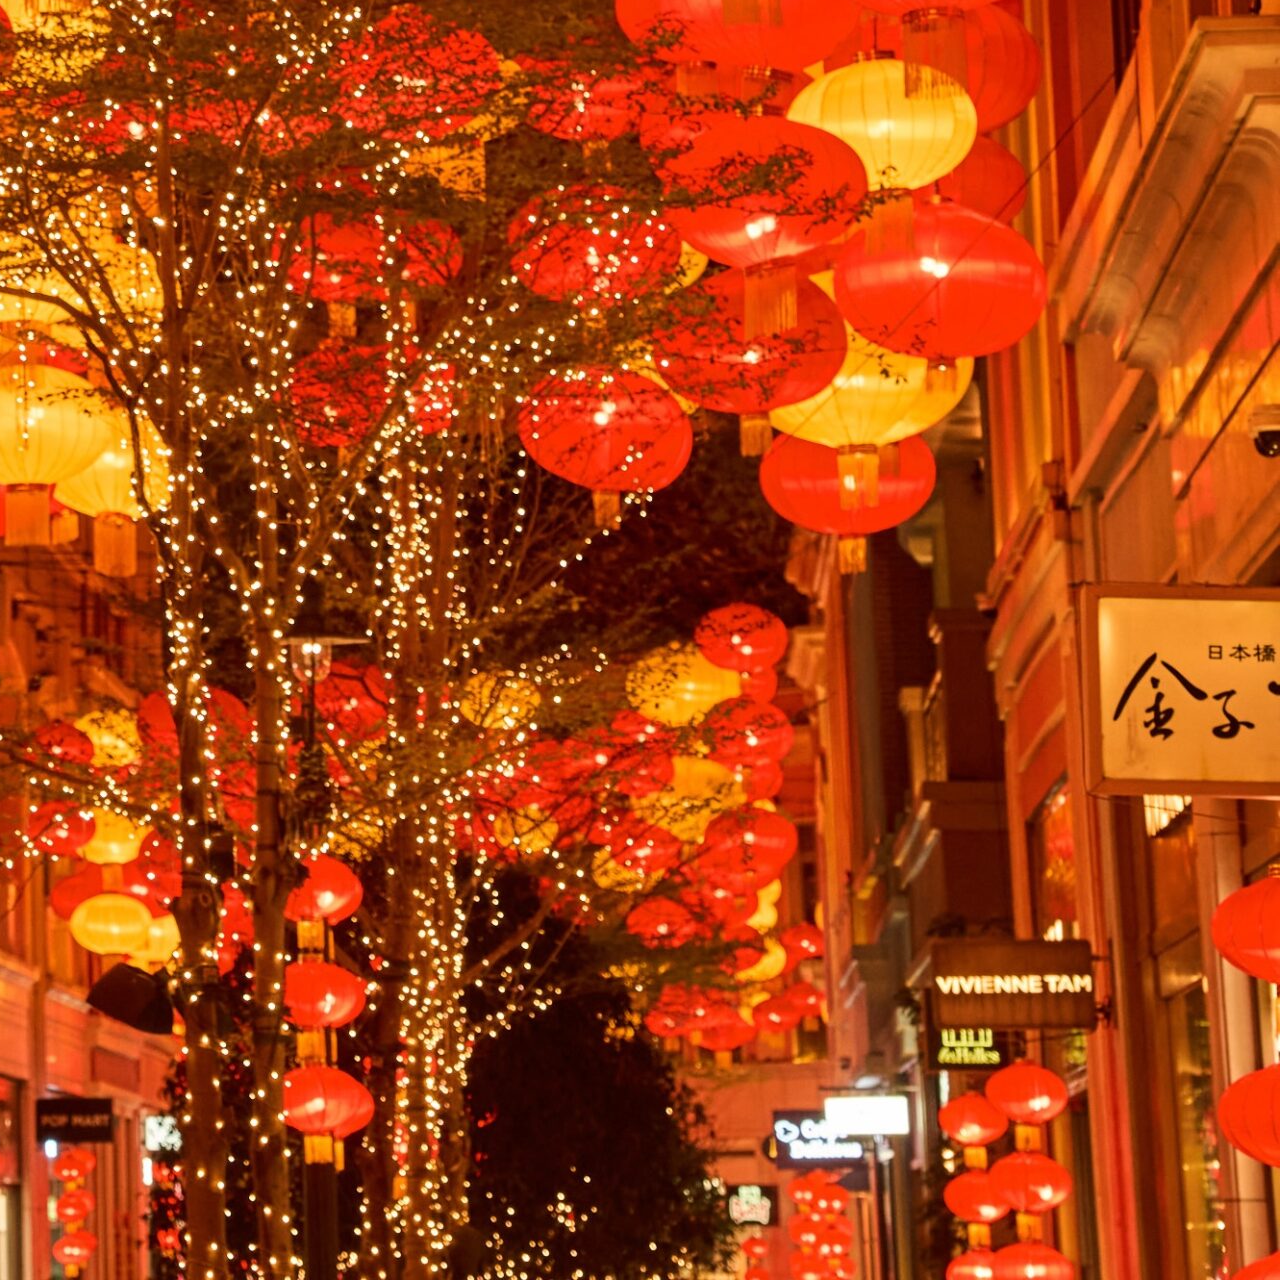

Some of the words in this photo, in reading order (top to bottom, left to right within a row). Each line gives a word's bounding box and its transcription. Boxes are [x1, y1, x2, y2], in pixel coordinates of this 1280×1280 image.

[1208, 643, 1277, 663] 日本橋
[1113, 652, 1280, 741] 金子
[935, 975, 1043, 995] VIVIENNE
[1043, 974, 1093, 994] TAM
[40, 1113, 69, 1128] POP
[71, 1113, 110, 1128] MART
